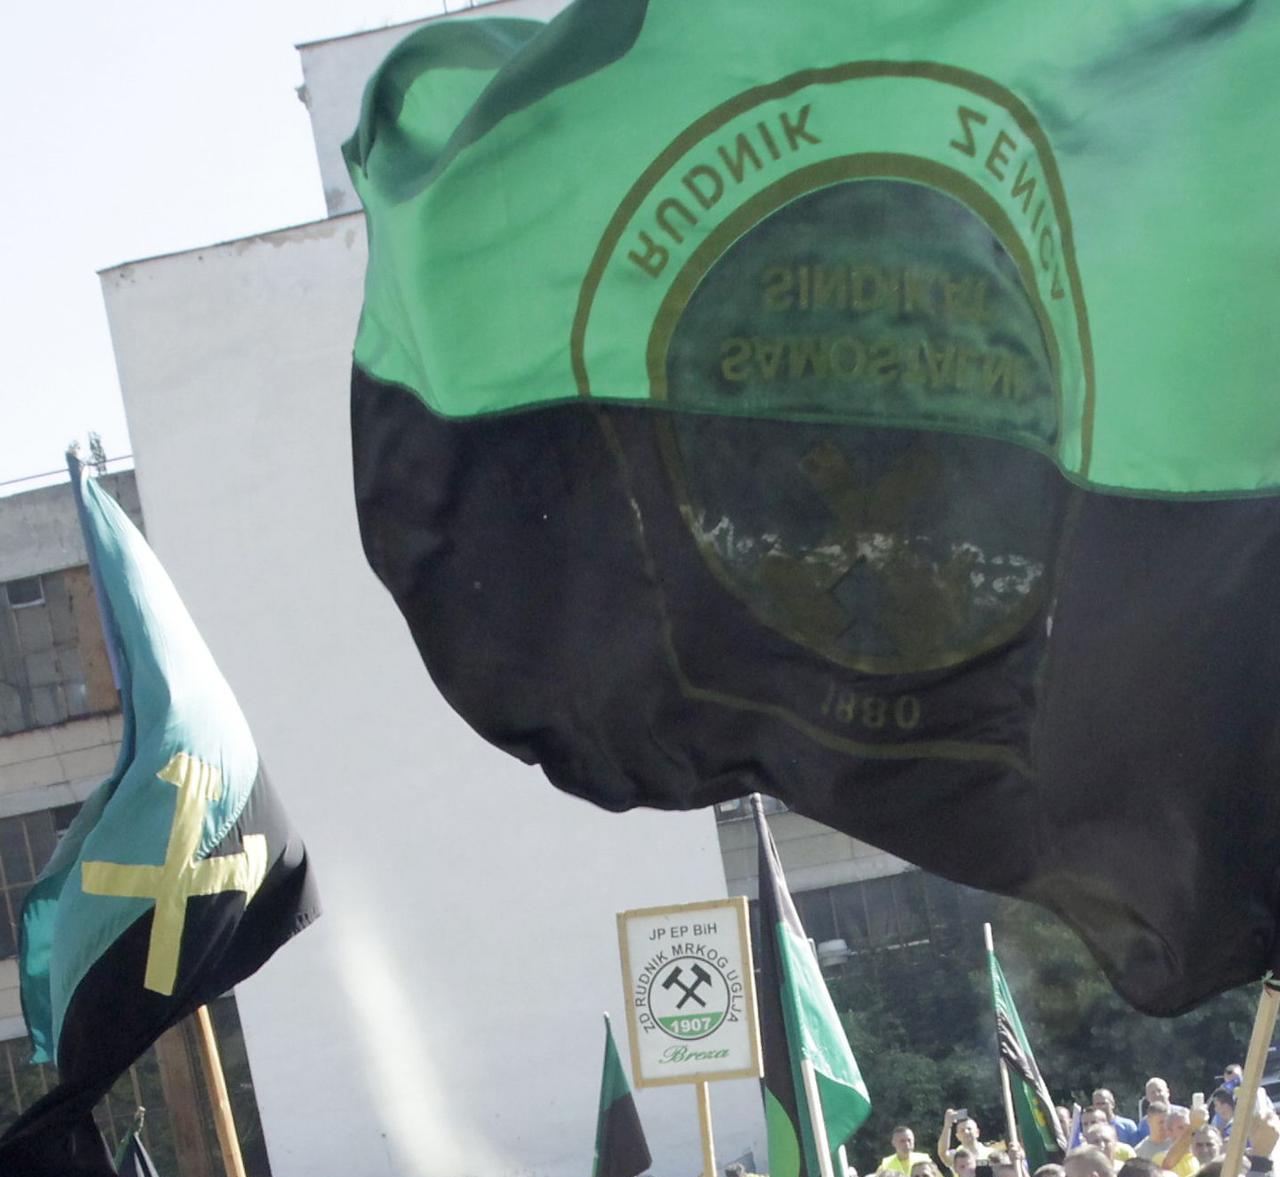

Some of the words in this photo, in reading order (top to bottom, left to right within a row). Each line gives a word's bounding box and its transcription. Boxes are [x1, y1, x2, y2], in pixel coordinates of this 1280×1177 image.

[649, 928, 666, 941] JP
[670, 925, 689, 938] EP
[693, 923, 718, 936] BiH
[671, 943, 729, 969] MRKOG
[635, 951, 668, 1008] RUDNIK
[726, 969, 743, 1023] UGLJA
[639, 1012, 656, 1033] ZD
[670, 1017, 712, 1034] 1907
[658, 1045, 731, 1064] Breza
